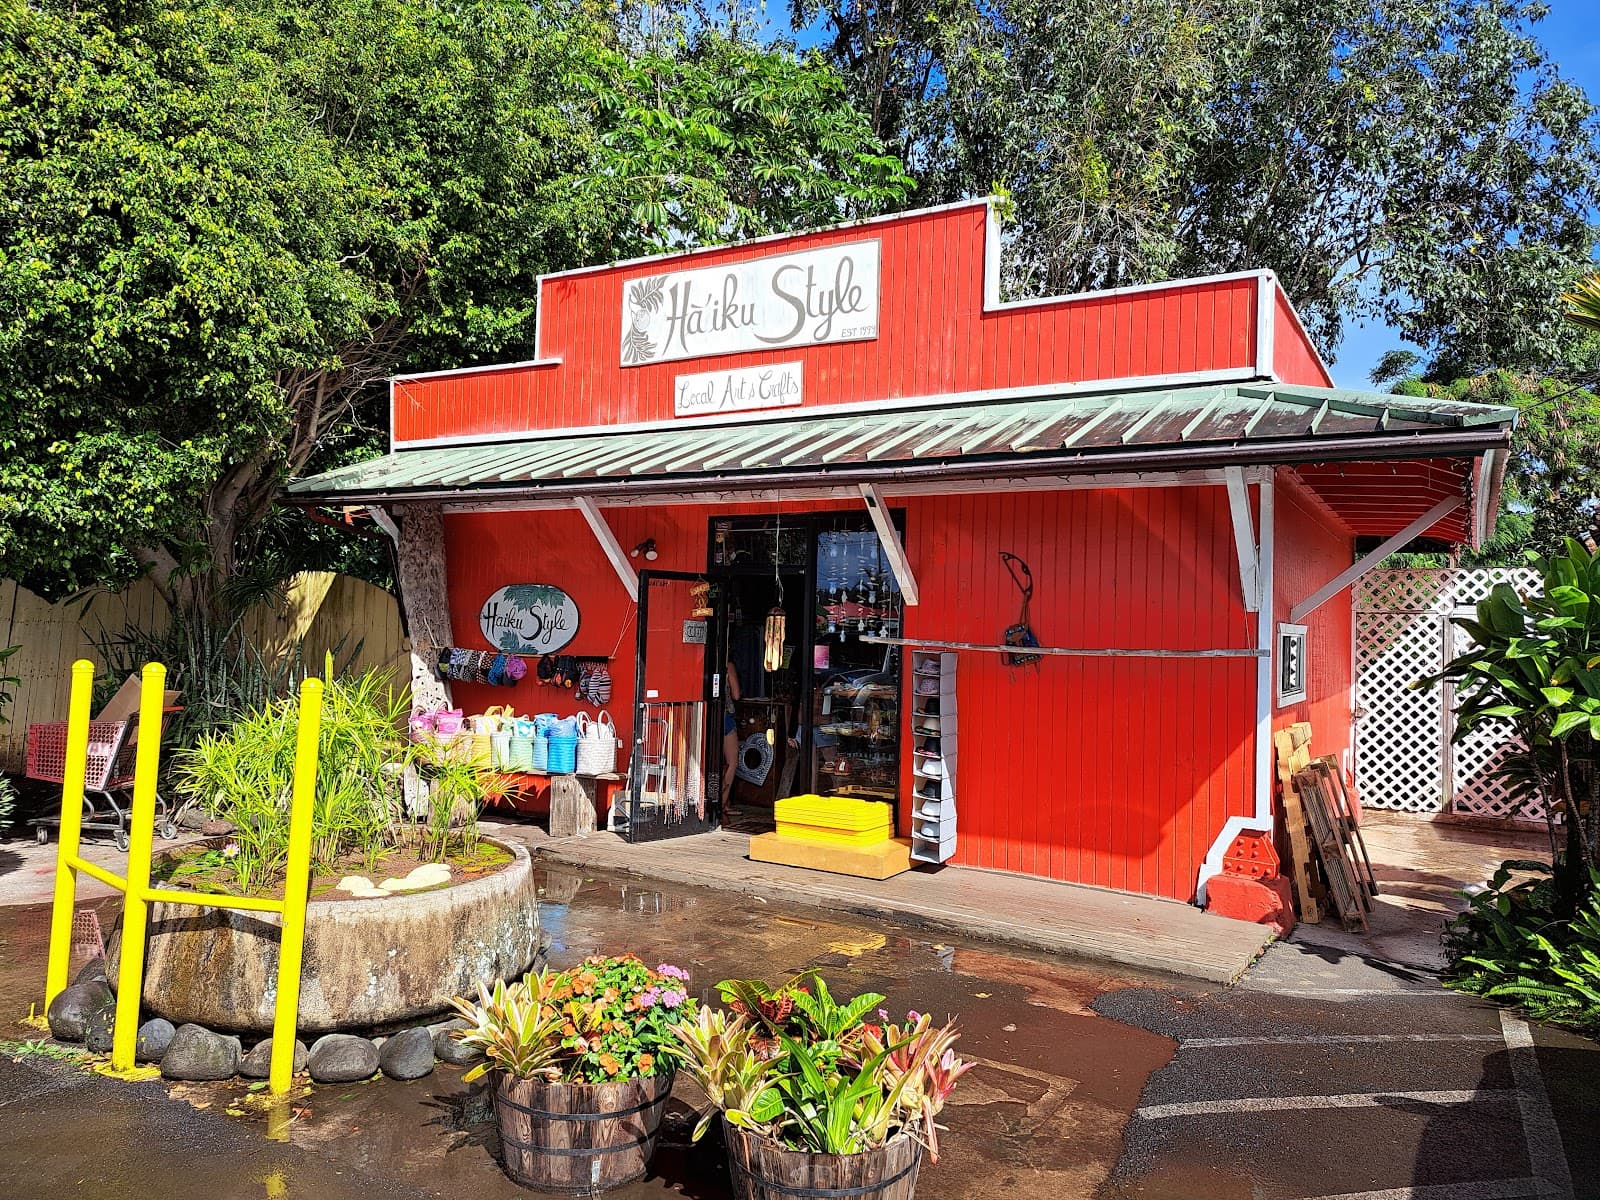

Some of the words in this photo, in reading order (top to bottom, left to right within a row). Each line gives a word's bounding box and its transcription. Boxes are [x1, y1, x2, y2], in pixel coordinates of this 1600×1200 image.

[753, 256, 870, 345] Style
[677, 379, 714, 409] Local
[759, 370, 799, 404] Crafts
[483, 602, 524, 642] Haiku
[519, 605, 569, 645] Style
